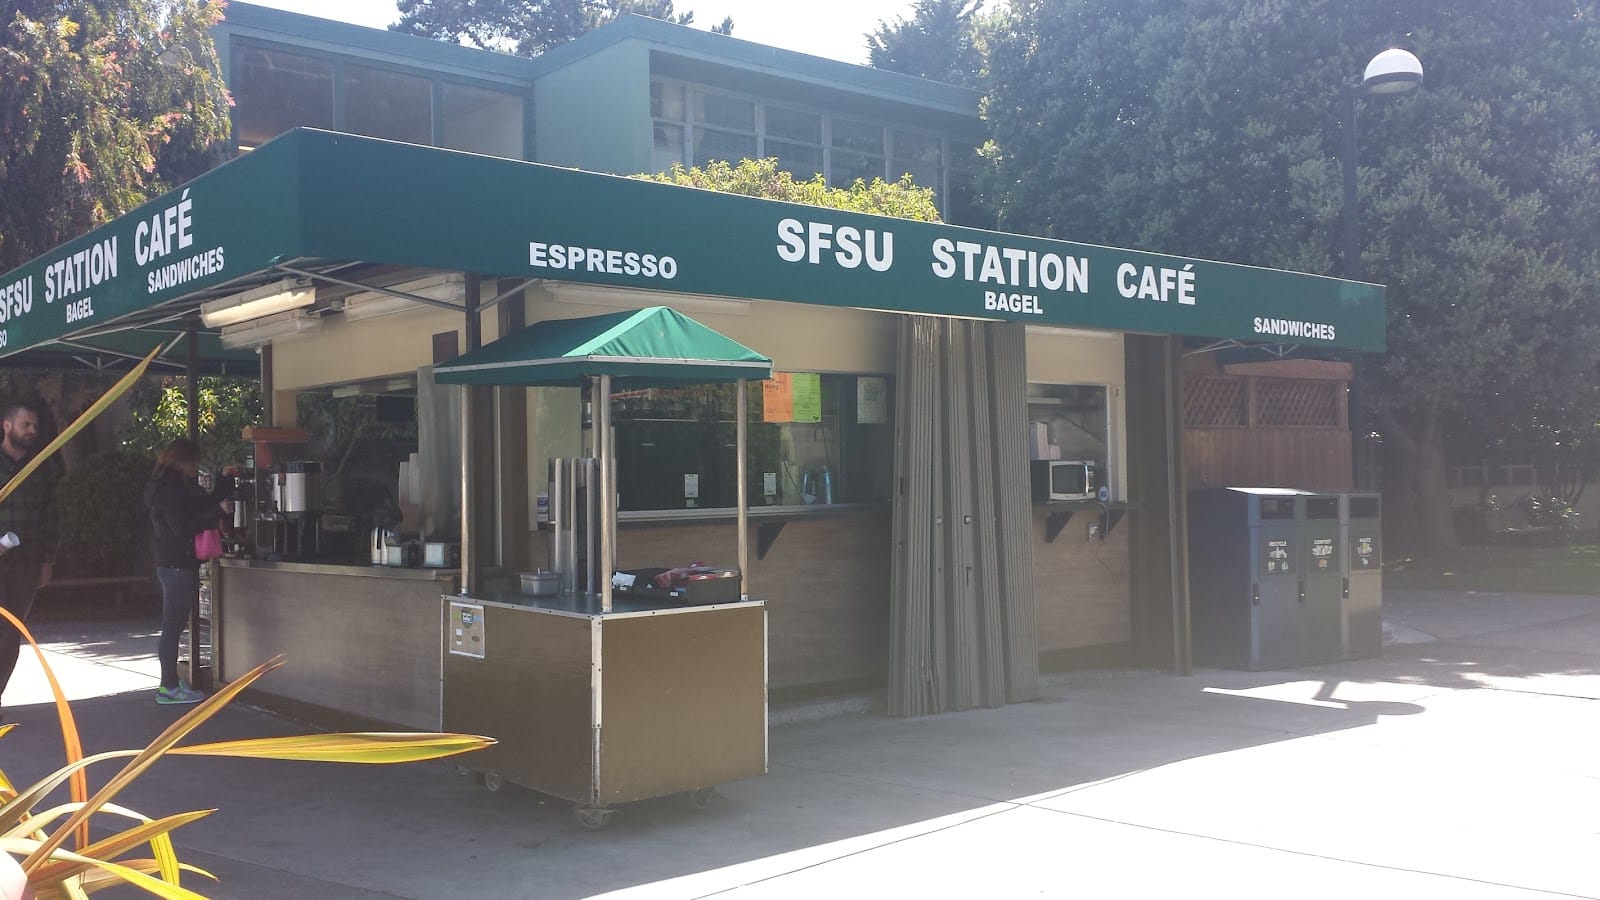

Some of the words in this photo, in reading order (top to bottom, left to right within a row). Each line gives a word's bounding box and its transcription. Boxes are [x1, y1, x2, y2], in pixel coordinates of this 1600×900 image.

[0, 275, 32, 323] SFSU
[45, 236, 117, 303] STATION
[135, 187, 193, 266] CAFÉ
[148, 246, 225, 294] SANDWICHES
[529, 242, 678, 279] ESPRESSO
[776, 218, 893, 272] SFSU
[932, 239, 1088, 293] STATION
[1117, 263, 1196, 306] CAFÉ
[66, 297, 94, 323] BAGEL
[984, 291, 1044, 315] BAGEL
[1254, 317, 1336, 341] SANDWICHES
